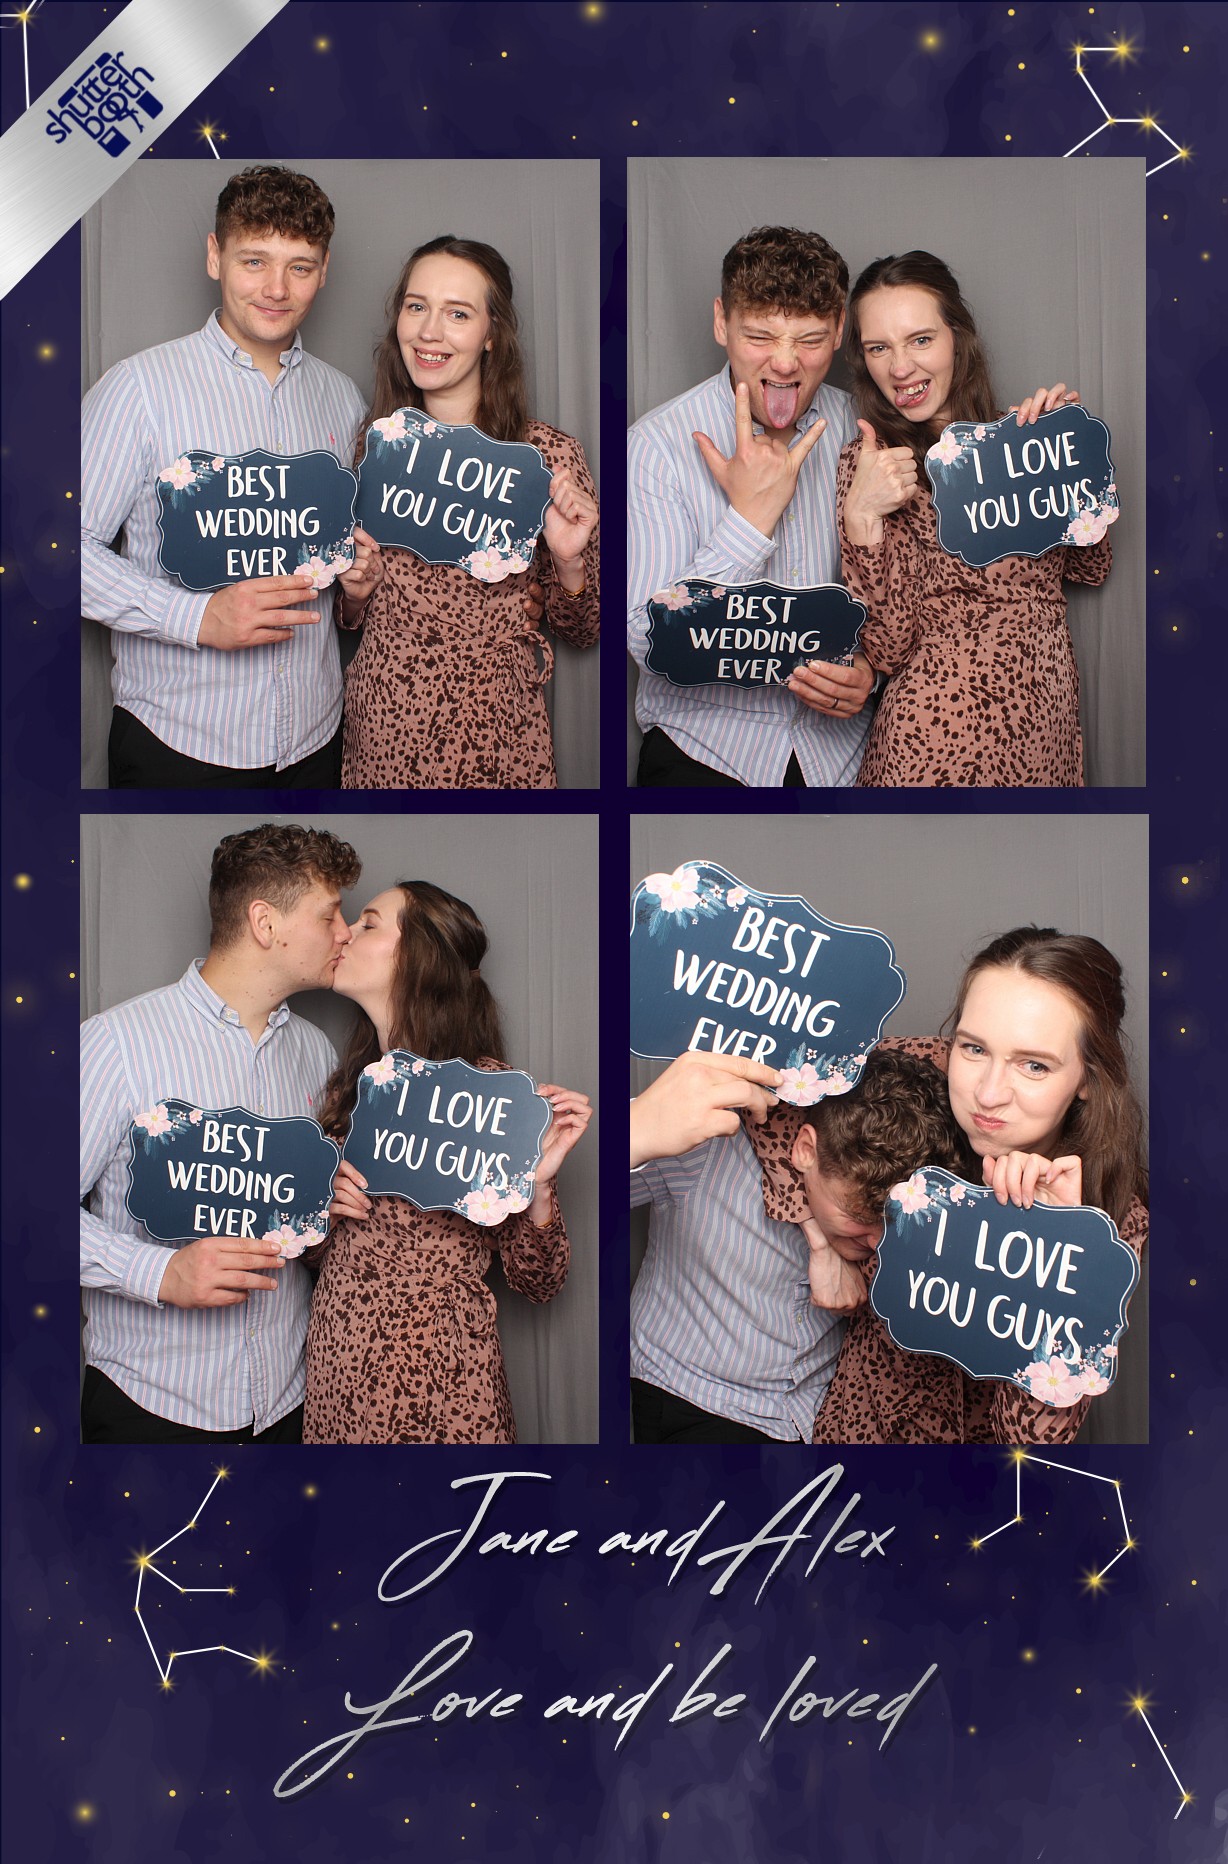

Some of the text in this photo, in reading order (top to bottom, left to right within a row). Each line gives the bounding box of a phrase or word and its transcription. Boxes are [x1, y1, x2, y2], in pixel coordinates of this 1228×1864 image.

[406, 438, 521, 503] I LOVE
[972, 431, 1080, 484] I LOVE
[228, 465, 290, 502] BEST
[963, 477, 1099, 534] YOU GUYS
[195, 506, 320, 539] WEDDING
[380, 483, 515, 553] YOU GUYS
[226, 546, 288, 578] EVER
[726, 594, 797, 625] BEST
[689, 626, 821, 654] WEDDING
[716, 658, 782, 684] EVER
[731, 906, 830, 979] BEST
[672, 949, 841, 1038] WEDDING
[687, 1016, 778, 1065] EVER
[397, 1079, 513, 1136] I LOVE
[202, 1120, 271, 1162] BEST
[372, 1128, 511, 1191] YOU GUYS
[167, 1159, 295, 1204] WEDDING
[193, 1204, 258, 1239] EVER
[933, 1210, 1085, 1295] I LOVE
[907, 1269, 1085, 1365] YOU GUYS
